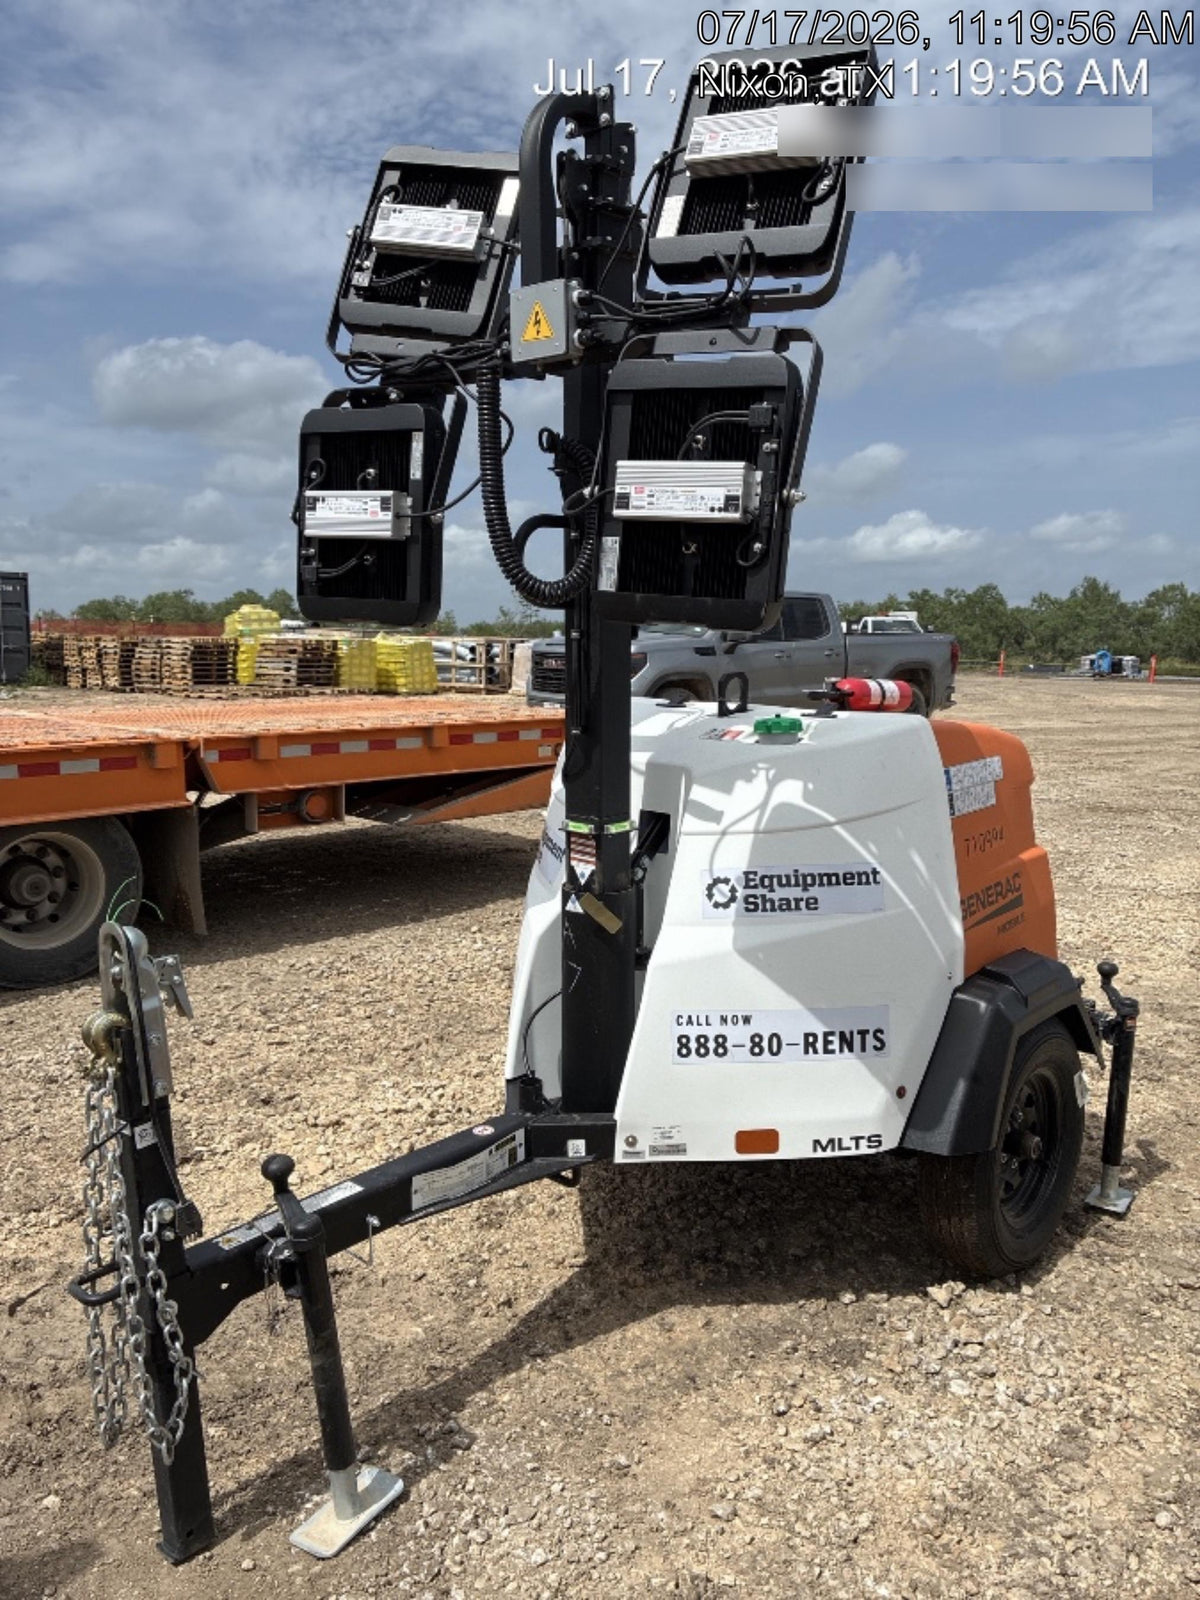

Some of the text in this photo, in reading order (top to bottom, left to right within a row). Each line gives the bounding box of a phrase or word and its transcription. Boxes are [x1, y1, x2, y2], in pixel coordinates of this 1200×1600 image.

[742, 867, 881, 893] Equipment
[743, 894, 819, 913] Share
[676, 1014, 753, 1027] CALL NOW
[676, 1028, 887, 1059] 888-80-RENTS
[812, 1133, 883, 1153] MLTS
